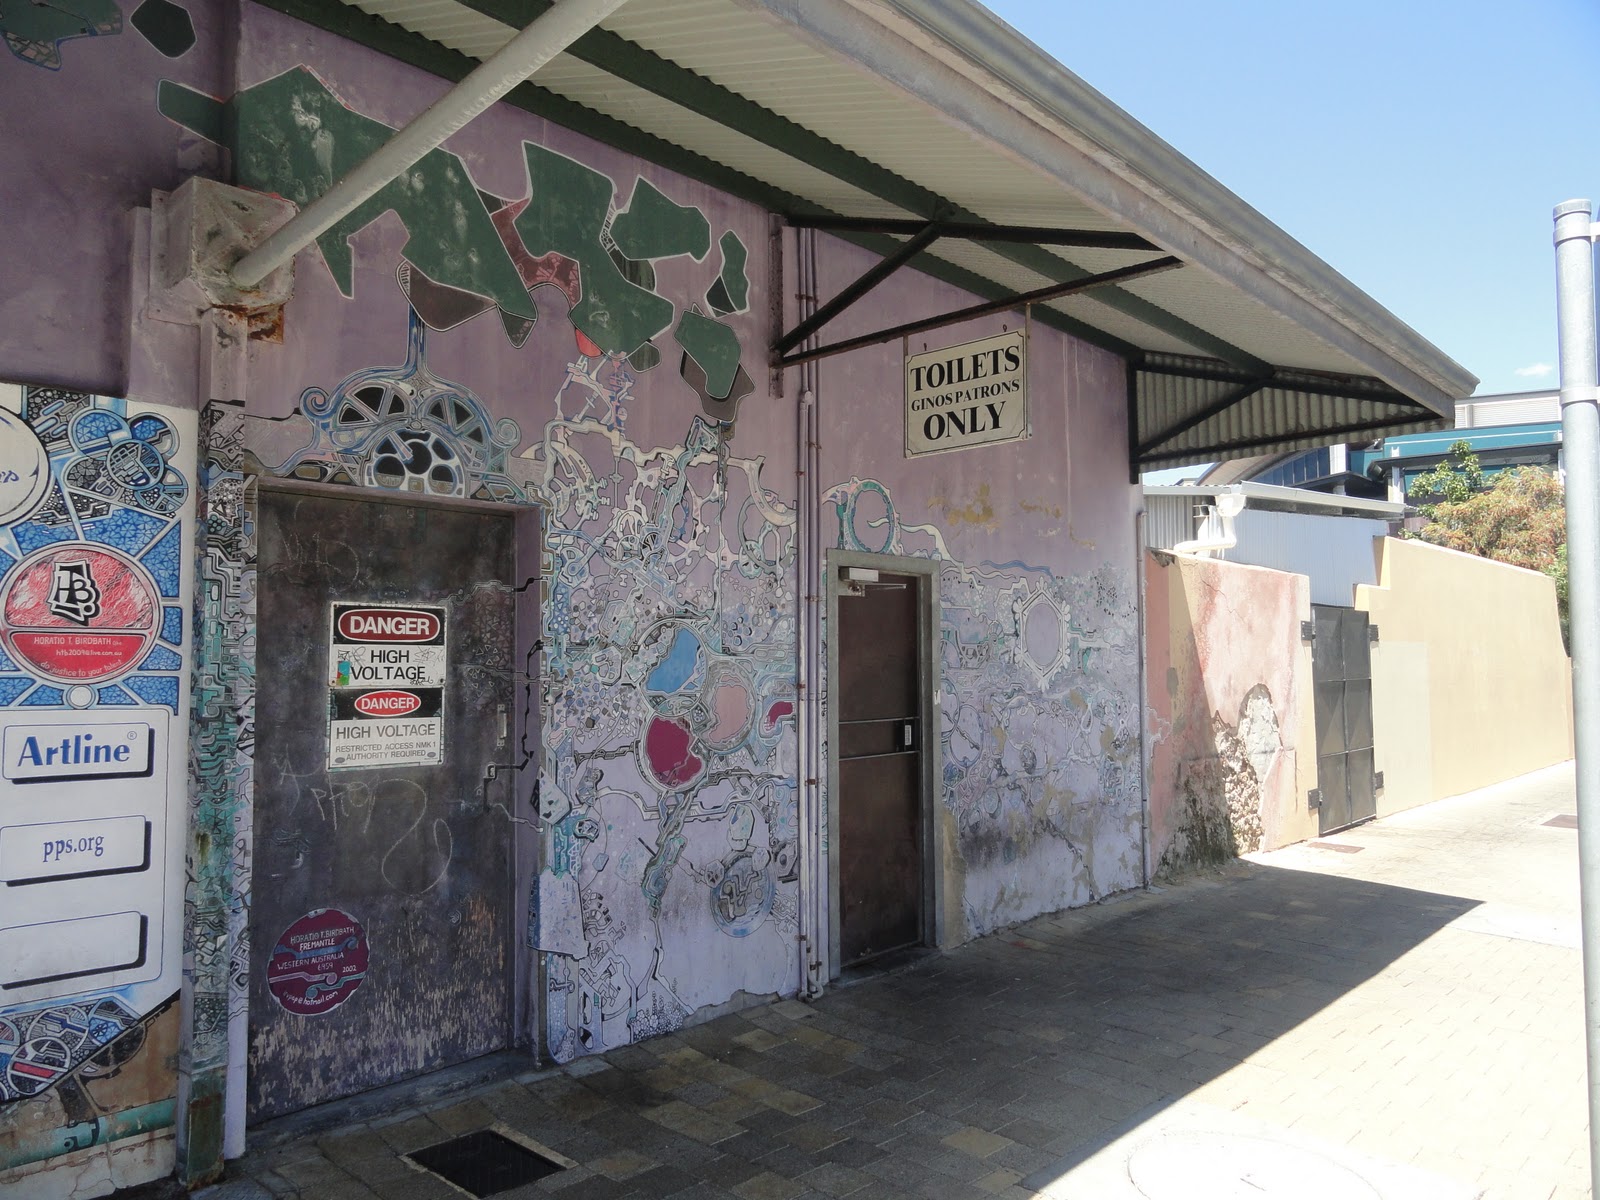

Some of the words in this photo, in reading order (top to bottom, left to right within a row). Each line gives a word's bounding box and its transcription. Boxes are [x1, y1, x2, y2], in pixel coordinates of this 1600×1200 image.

[910, 345, 1020, 392] TOILETS
[911, 392, 953, 412] GINOS
[954, 379, 1020, 404] PATRONS
[923, 400, 1007, 441] ONLY
[350, 615, 430, 636] DANGER
[33, 636, 65, 645] HORATIO
[75, 636, 112, 646] BIRDBATH
[370, 649, 410, 664] HIGH
[78, 669, 86, 677] to
[87, 667, 103, 678] your
[350, 666, 426, 681] VOLTAGE
[360, 697, 415, 710] DANGER
[336, 726, 371, 740] HIGH
[376, 723, 436, 738] VOLTAGE
[17, 733, 131, 767] Artline
[335, 743, 383, 753] RESTRICTED
[384, 742, 414, 751] ACCESS
[415, 741, 432, 749] NMK
[346, 751, 388, 761] AUTHORITY
[390, 749, 426, 759] REQUIRED
[42, 835, 104, 863] pps.org
[290, 932, 320, 945] HORATIO
[299, 938, 336, 952] FREMANTLE
[277, 958, 310, 971] WESTERN
[310, 952, 345, 964] AUSTRALIA
[342, 965, 357, 973] 2002
